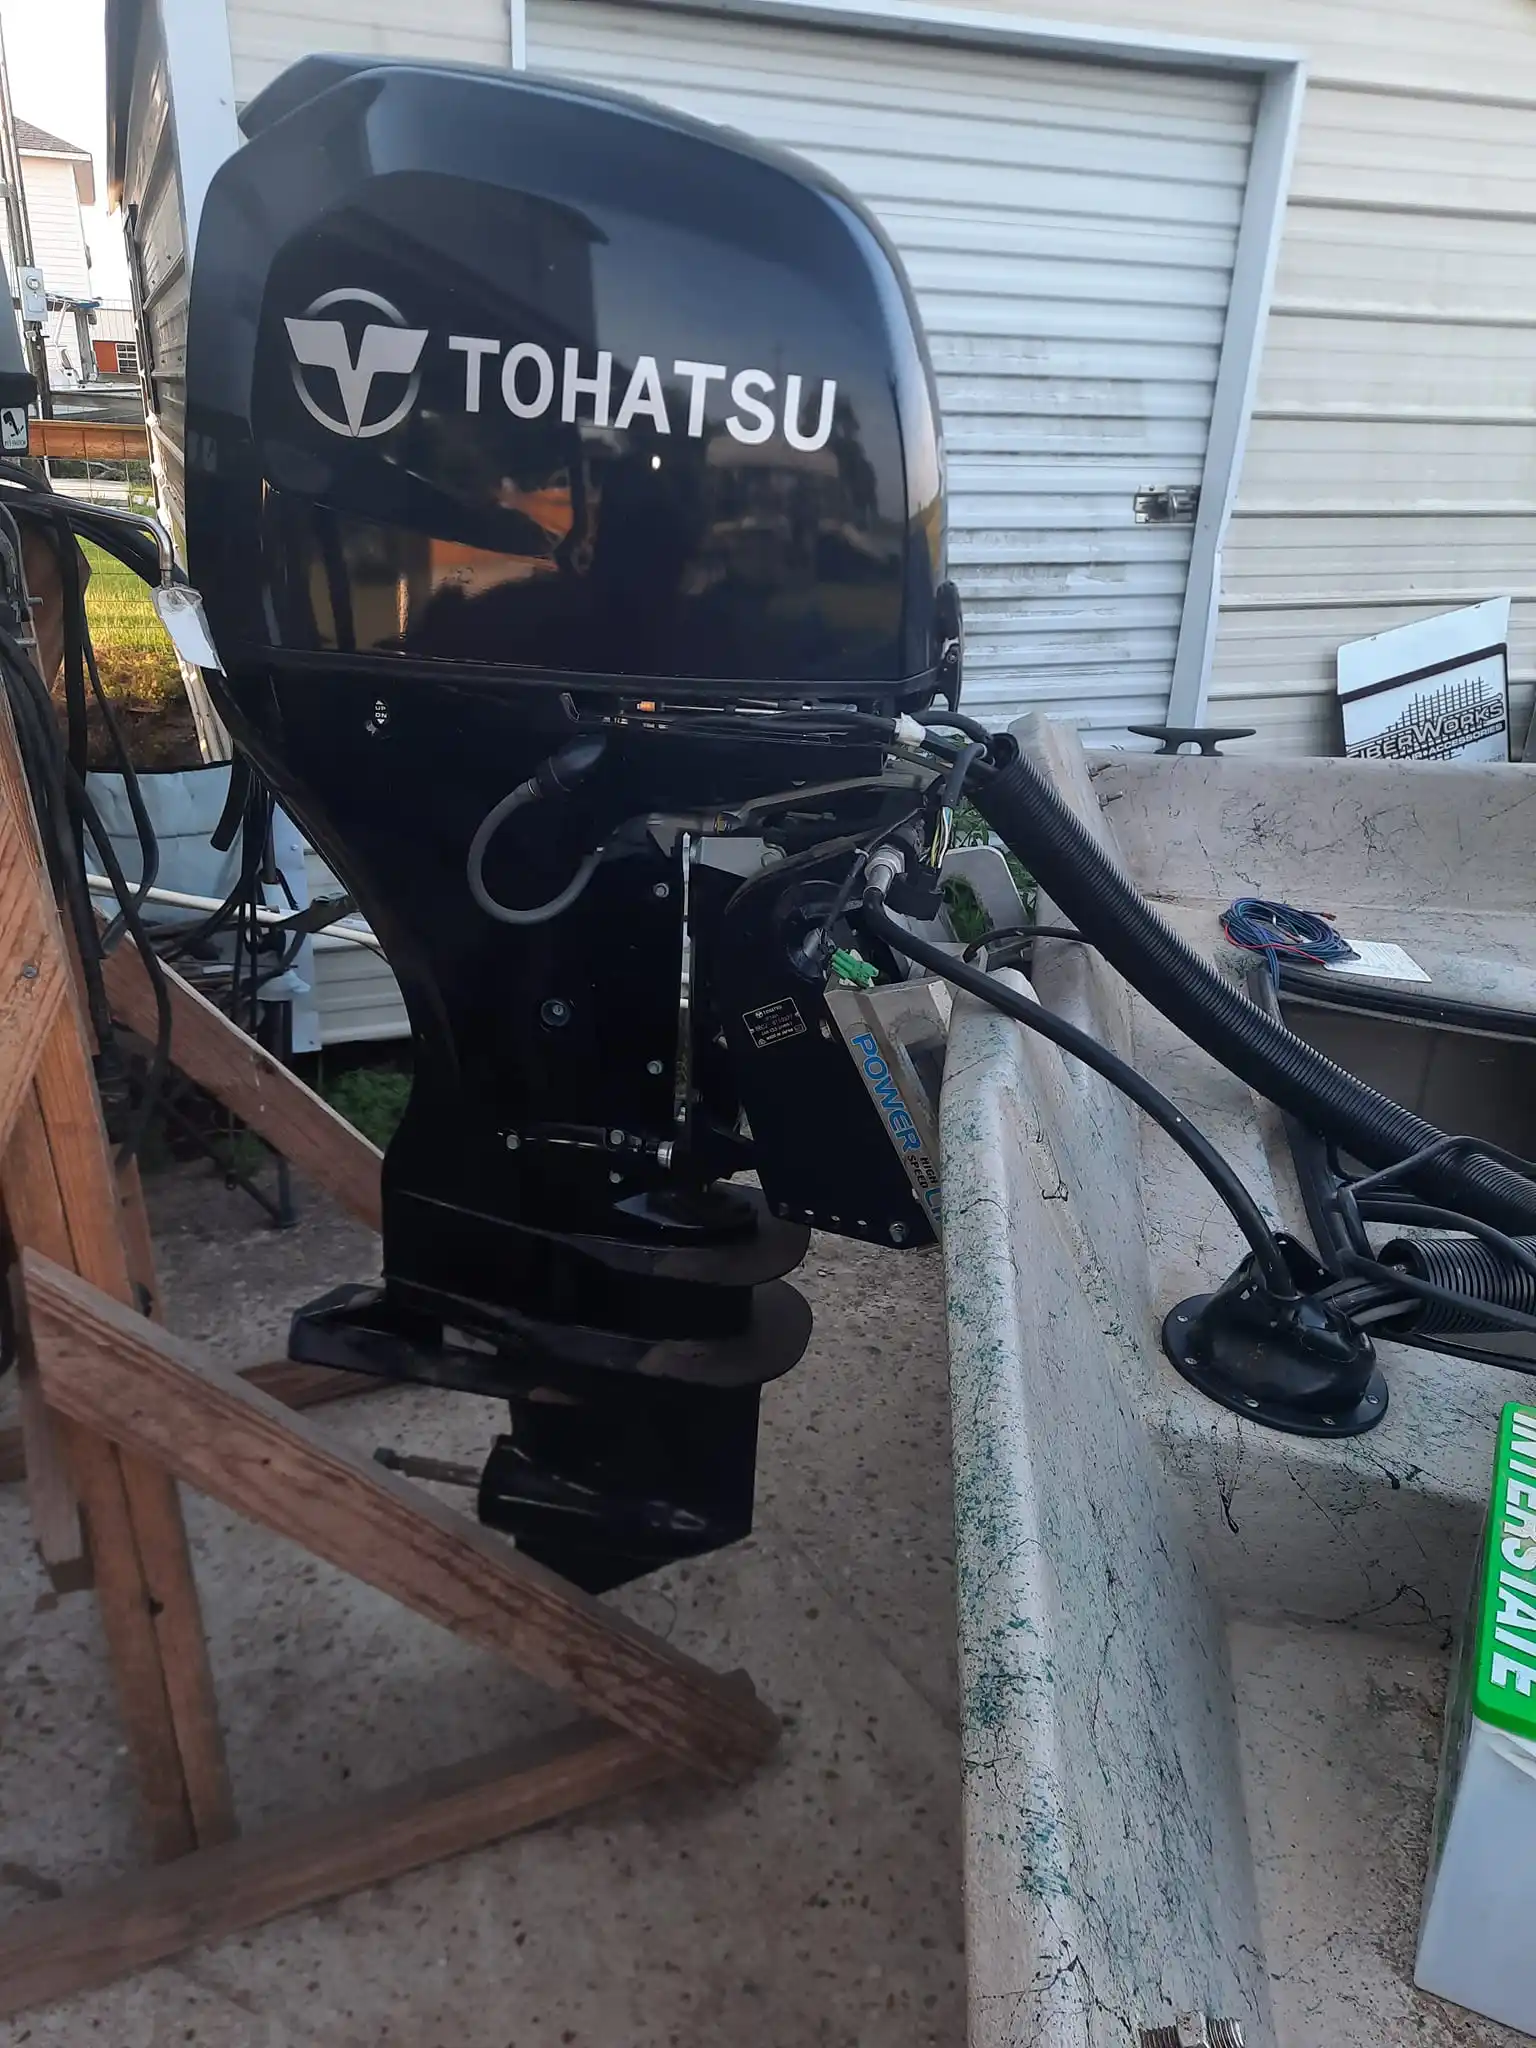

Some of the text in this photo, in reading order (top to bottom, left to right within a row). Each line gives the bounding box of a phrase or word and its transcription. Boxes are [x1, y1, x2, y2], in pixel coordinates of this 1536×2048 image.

[449, 335, 837, 452] TOHATSU
[1428, 722, 1504, 754] ACCESSORIES
[851, 1032, 921, 1152] POWER
[907, 1155, 929, 1189] SPEED
[919, 1157, 938, 1184] HIGH
